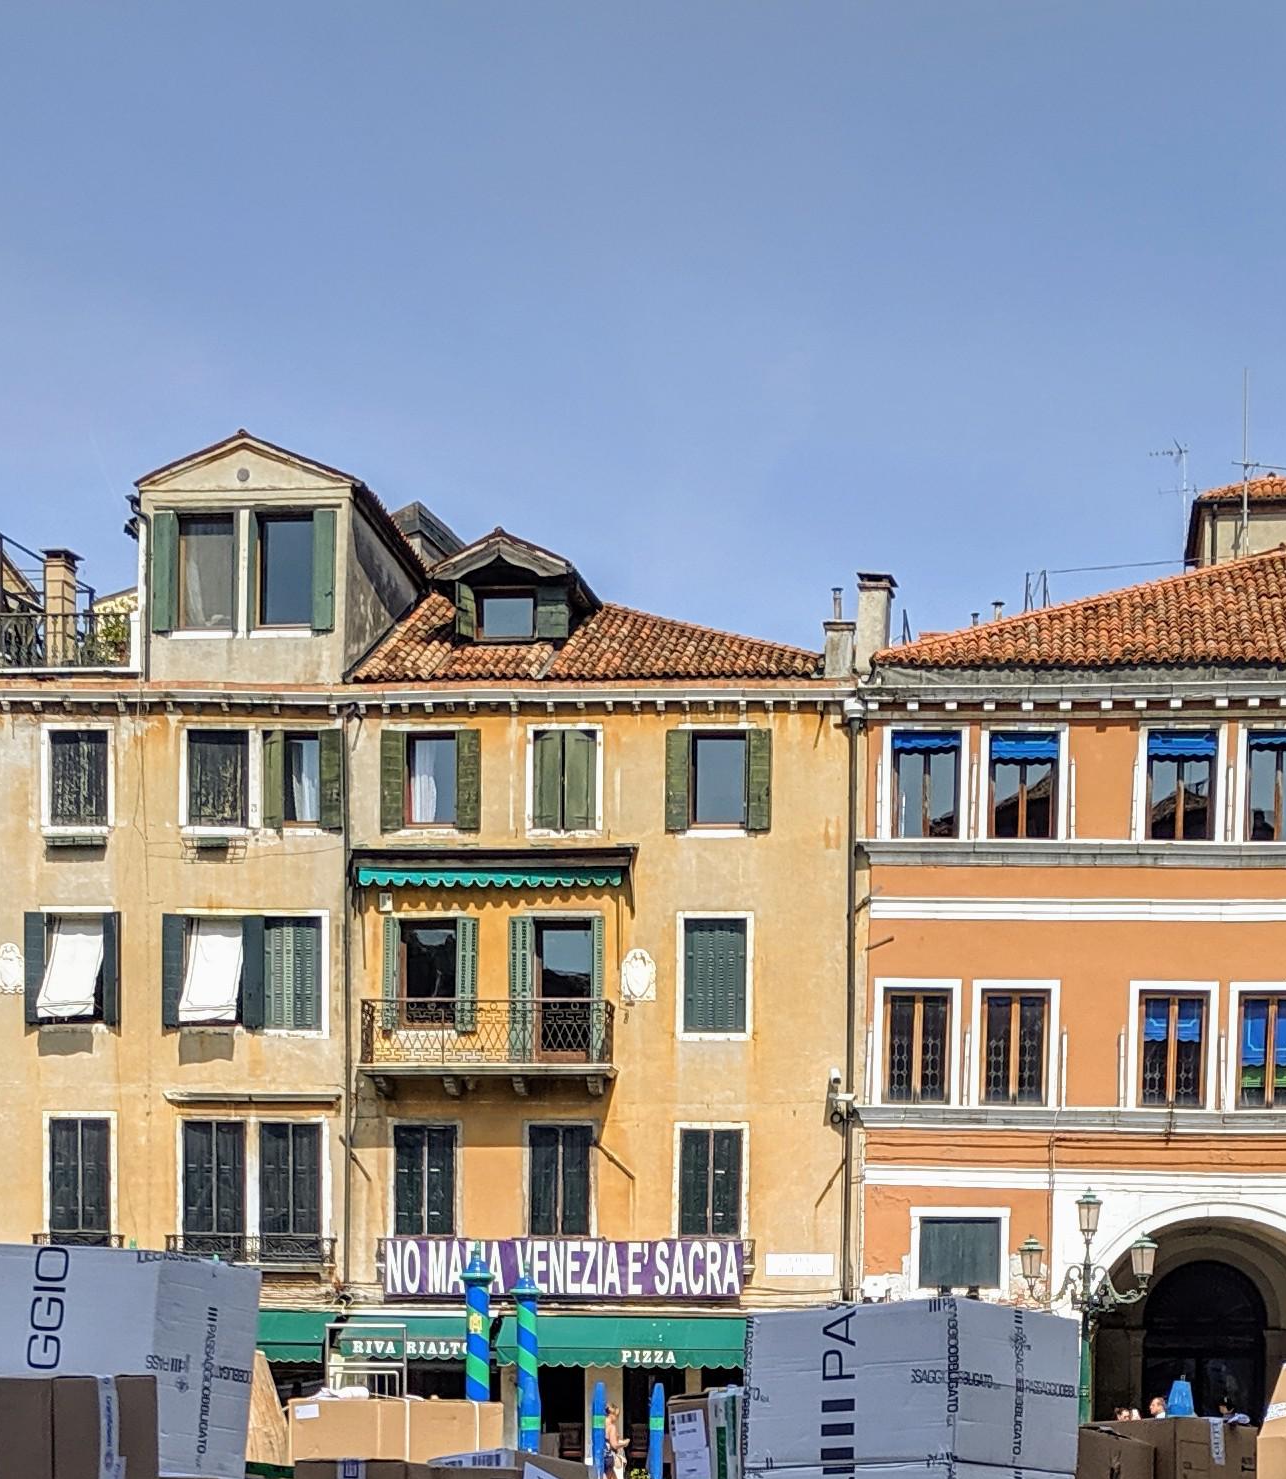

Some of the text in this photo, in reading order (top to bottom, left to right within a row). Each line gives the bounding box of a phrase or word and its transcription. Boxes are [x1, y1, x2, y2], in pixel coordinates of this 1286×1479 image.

[387, 1241, 420, 1295] NO
[515, 1241, 621, 1295] VENEZIA
[654, 1241, 741, 1295] SACRA
[27, 1246, 70, 1370] GGIO
[352, 1340, 396, 1354] RIVA
[621, 1350, 677, 1364] PIZZA
